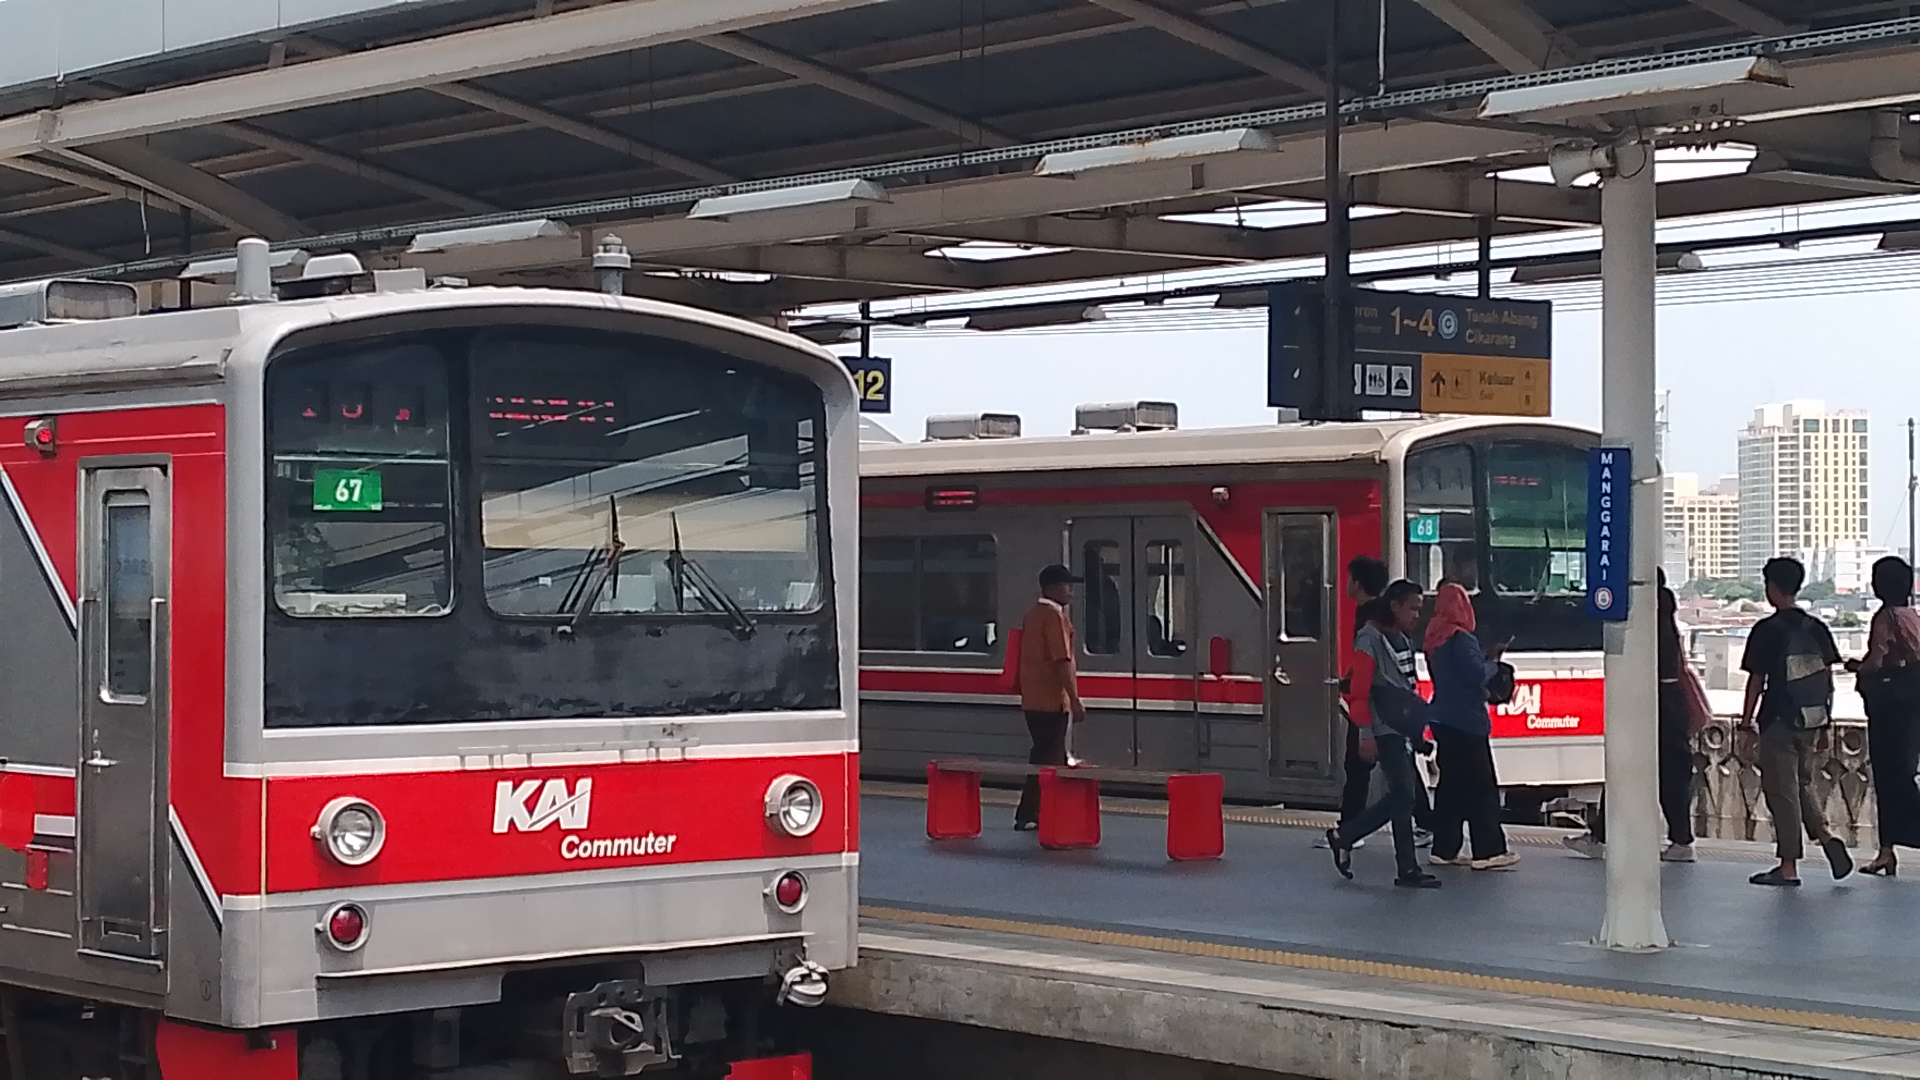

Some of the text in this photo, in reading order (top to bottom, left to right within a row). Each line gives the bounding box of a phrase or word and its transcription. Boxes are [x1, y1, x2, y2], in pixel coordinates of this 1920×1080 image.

[1390, 306, 1436, 337] 1~4
[1465, 328, 1516, 349] Cikarang
[853, 369, 885, 400] 12
[335, 478, 363, 502] 67
[1417, 519, 1433, 536] 68
[1600, 452, 1614, 581] MANGGARAI
[1526, 714, 1580, 729] Commuter
[492, 777, 592, 833] KAI
[560, 831, 676, 859] Commuter
